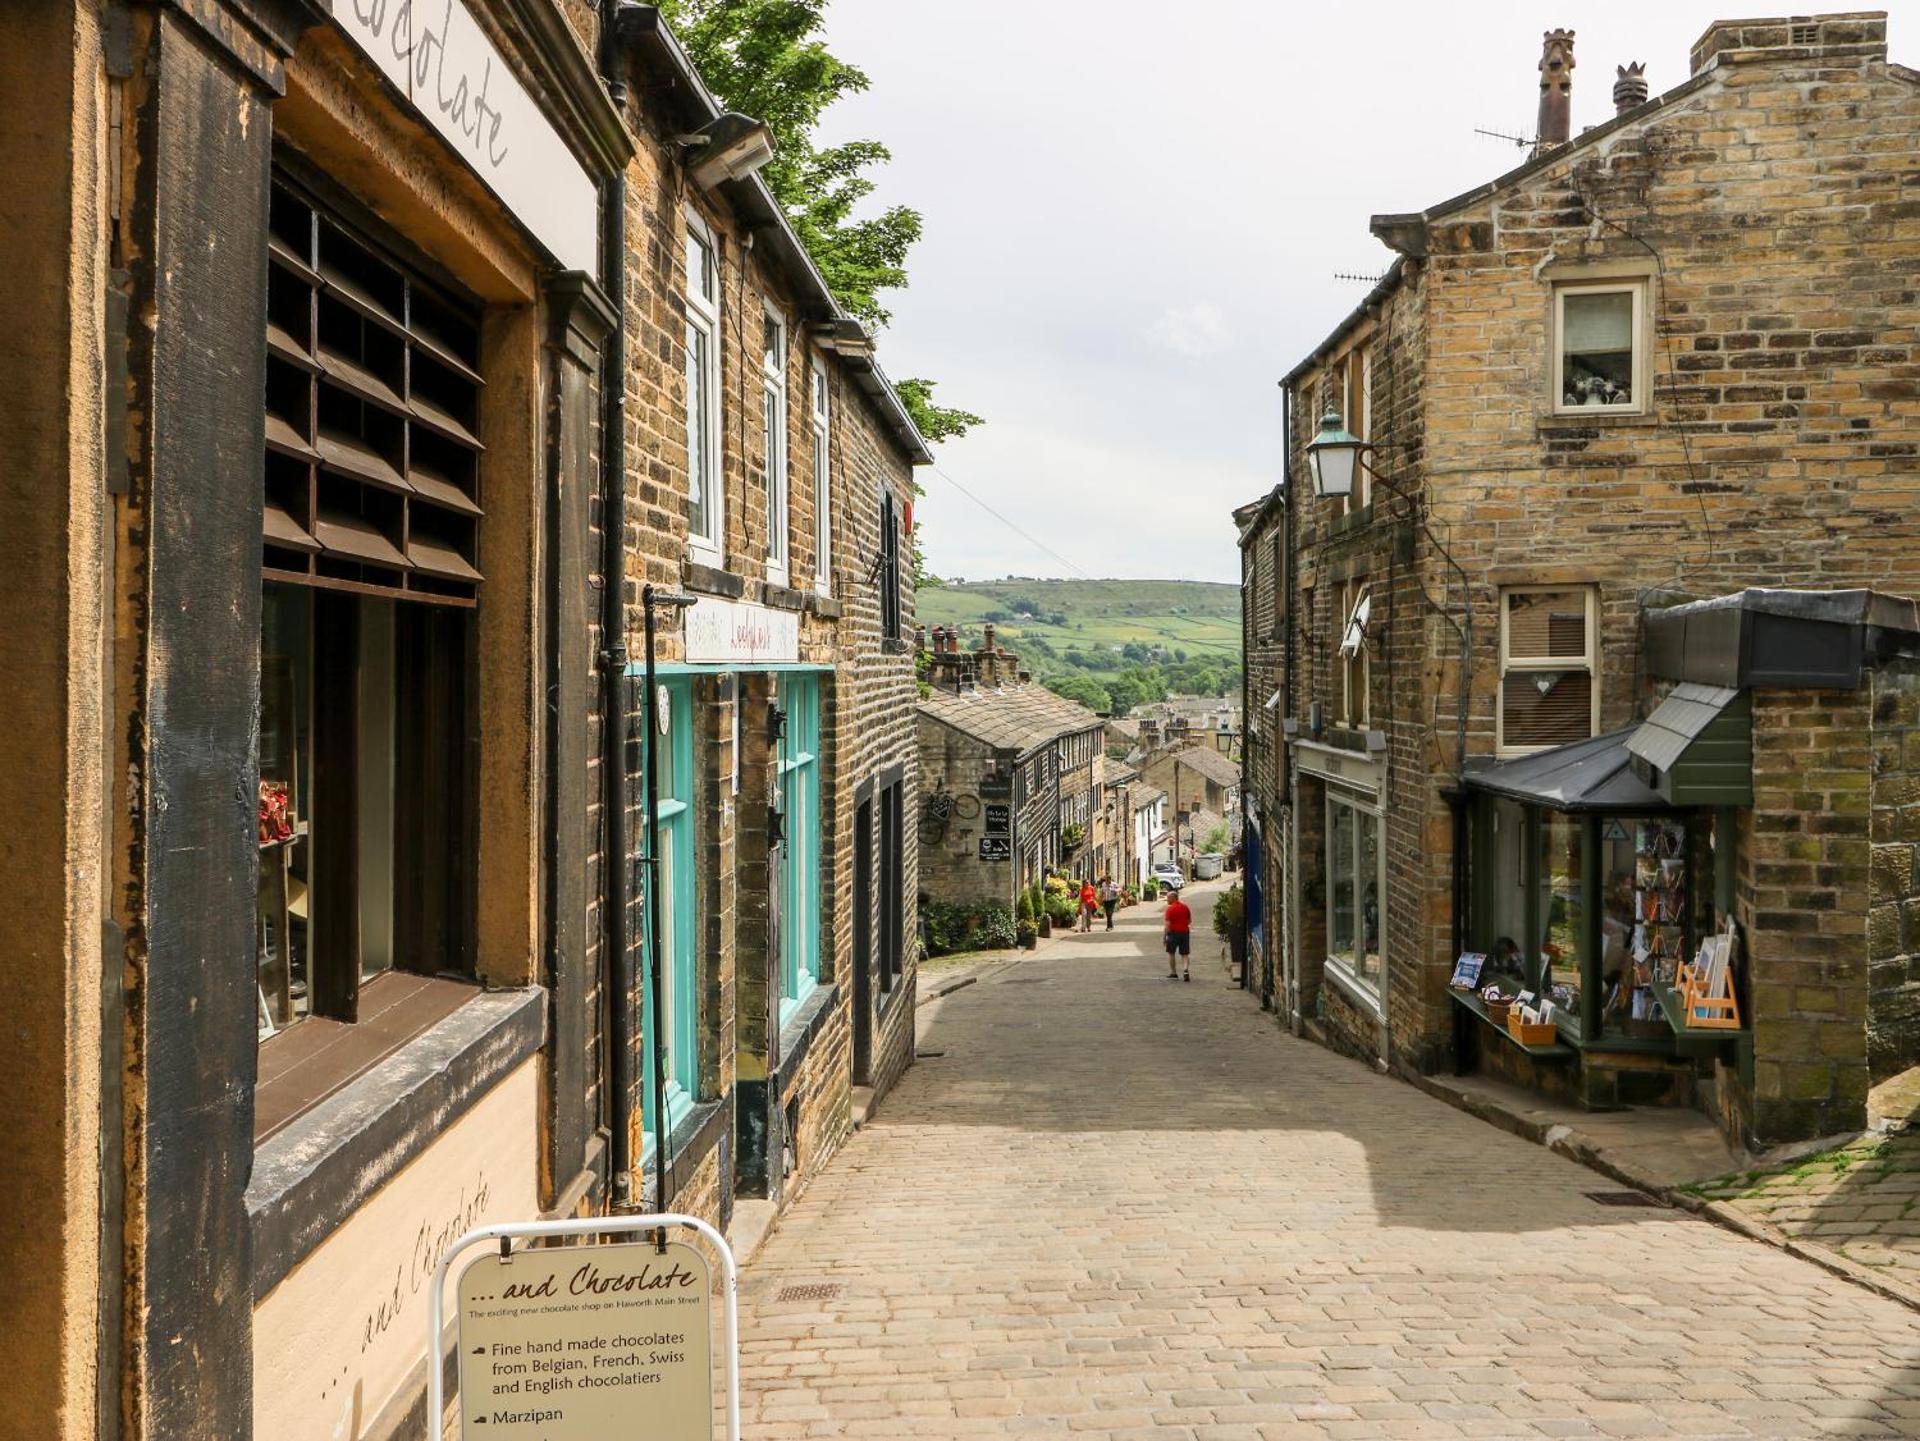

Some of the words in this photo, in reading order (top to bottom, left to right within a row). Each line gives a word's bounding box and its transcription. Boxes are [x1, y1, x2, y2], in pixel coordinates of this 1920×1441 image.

[569, 1262, 697, 1296] Chocolate
[469, 1310, 486, 1319] The
[487, 1307, 518, 1318] exciting
[520, 1307, 539, 1315] new
[541, 1303, 579, 1314] chocolate
[581, 1301, 602, 1311] shop
[603, 1301, 614, 1309] on
[616, 1297, 654, 1308] Haworth
[655, 1296, 676, 1306] Main
[678, 1295, 700, 1305] Street
[492, 1343, 522, 1357] Fine
[526, 1338, 563, 1354] hand
[567, 1336, 607, 1351] made
[611, 1332, 685, 1348] chocolates
[492, 1362, 527, 1376] from
[649, 1351, 685, 1365] Swiss
[492, 1380, 520, 1395] and
[525, 1377, 573, 1394] English
[577, 1372, 662, 1388] chocolatiers
[492, 1408, 563, 1425] Marzipan
